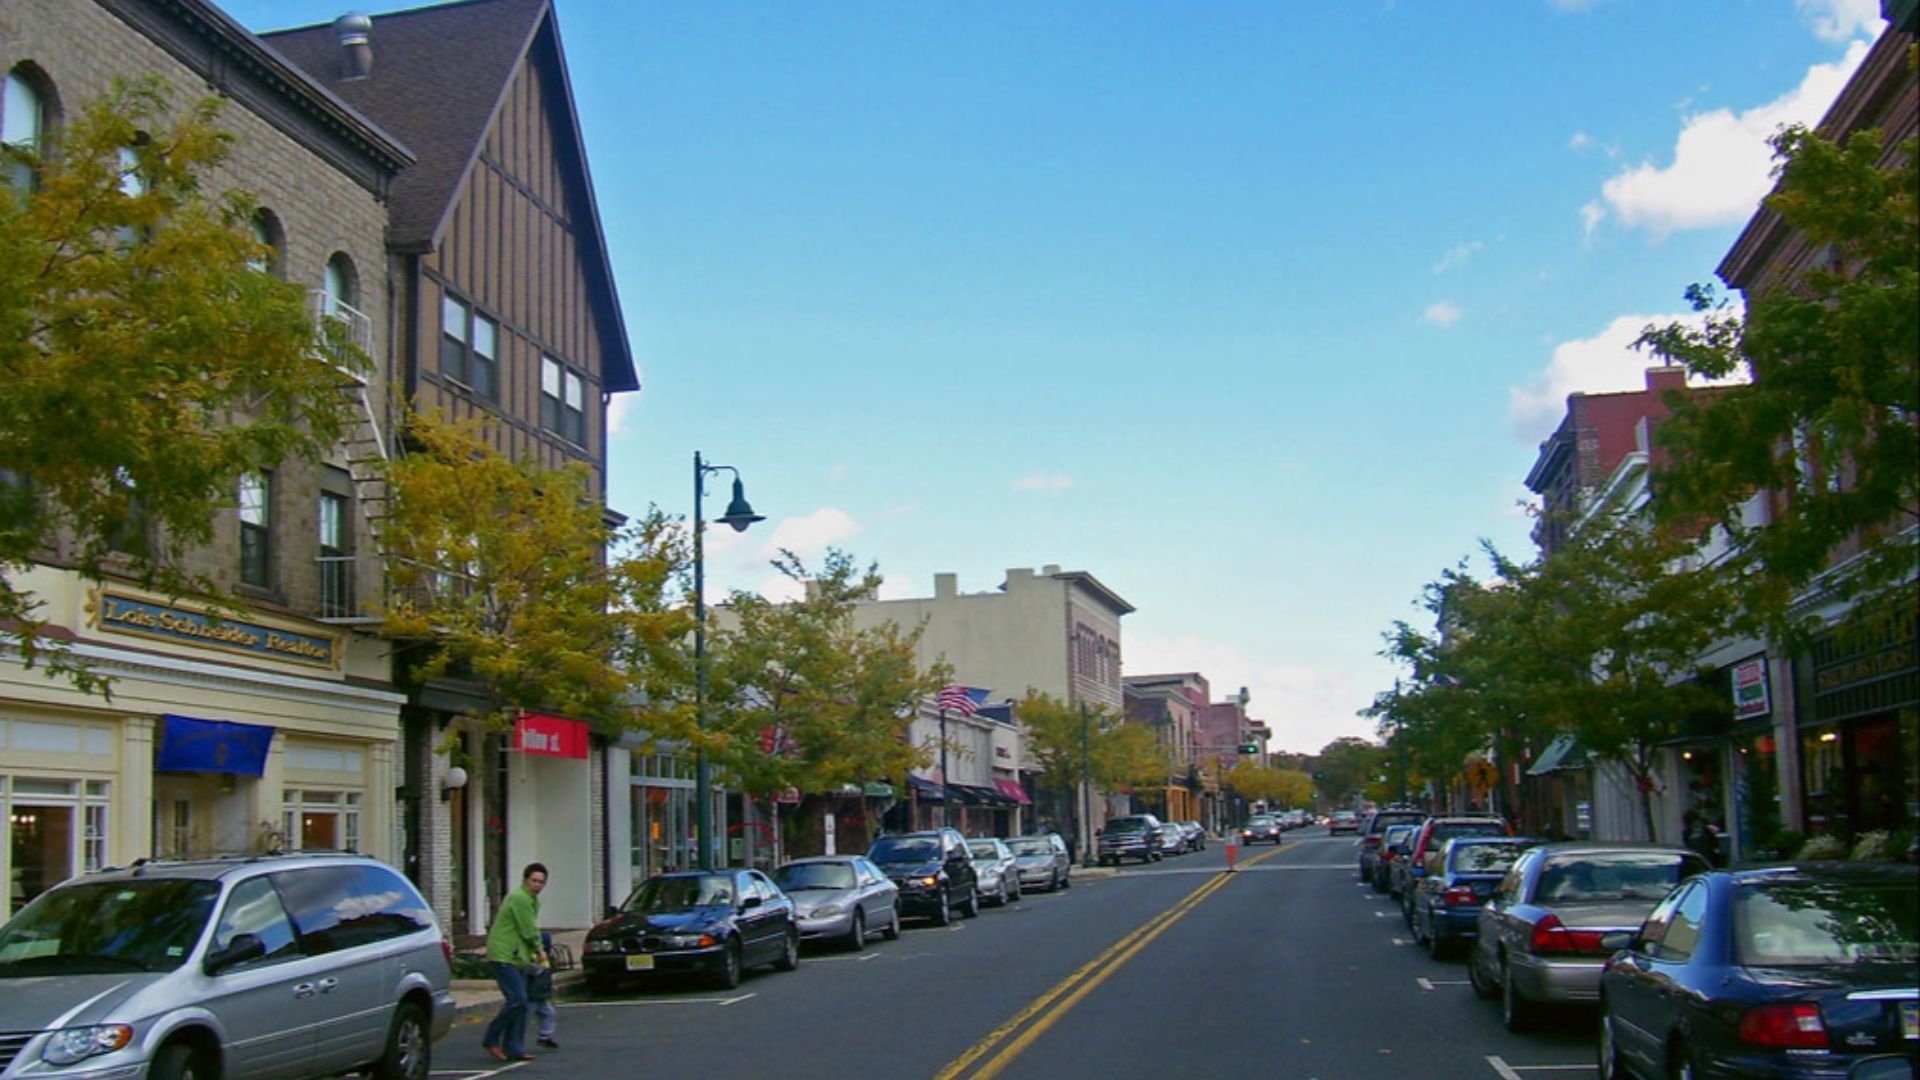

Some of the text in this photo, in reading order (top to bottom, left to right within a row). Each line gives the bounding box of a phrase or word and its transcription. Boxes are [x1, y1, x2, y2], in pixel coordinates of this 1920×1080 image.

[105, 601, 328, 659] Lois Schneider Realtor
